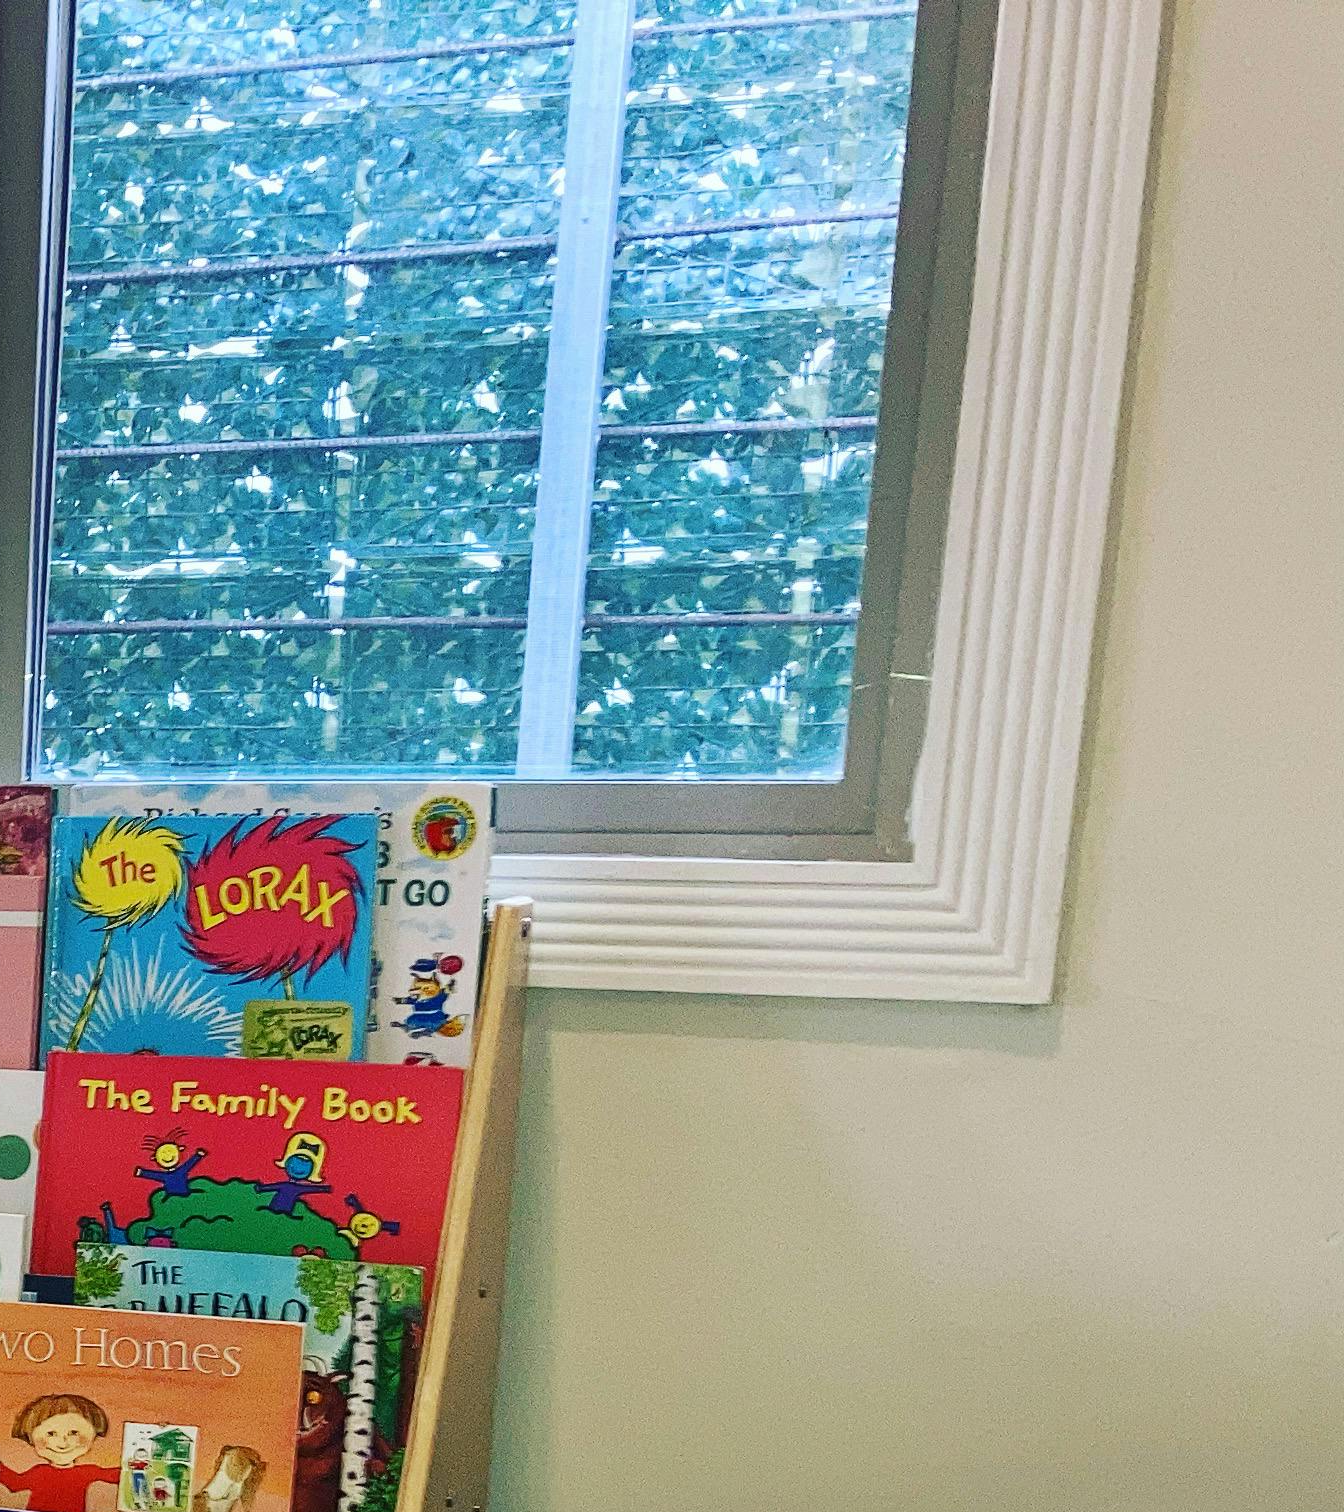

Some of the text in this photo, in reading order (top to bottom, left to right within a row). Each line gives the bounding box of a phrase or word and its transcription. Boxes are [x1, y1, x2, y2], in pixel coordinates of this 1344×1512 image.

[100, 853, 156, 888] The
[194, 864, 349, 931] LORAX
[404, 879, 450, 907] GO
[78, 1078, 424, 1129] The Family Book
[130, 1260, 186, 1285] THE
[71, 1326, 242, 1378] Homes
